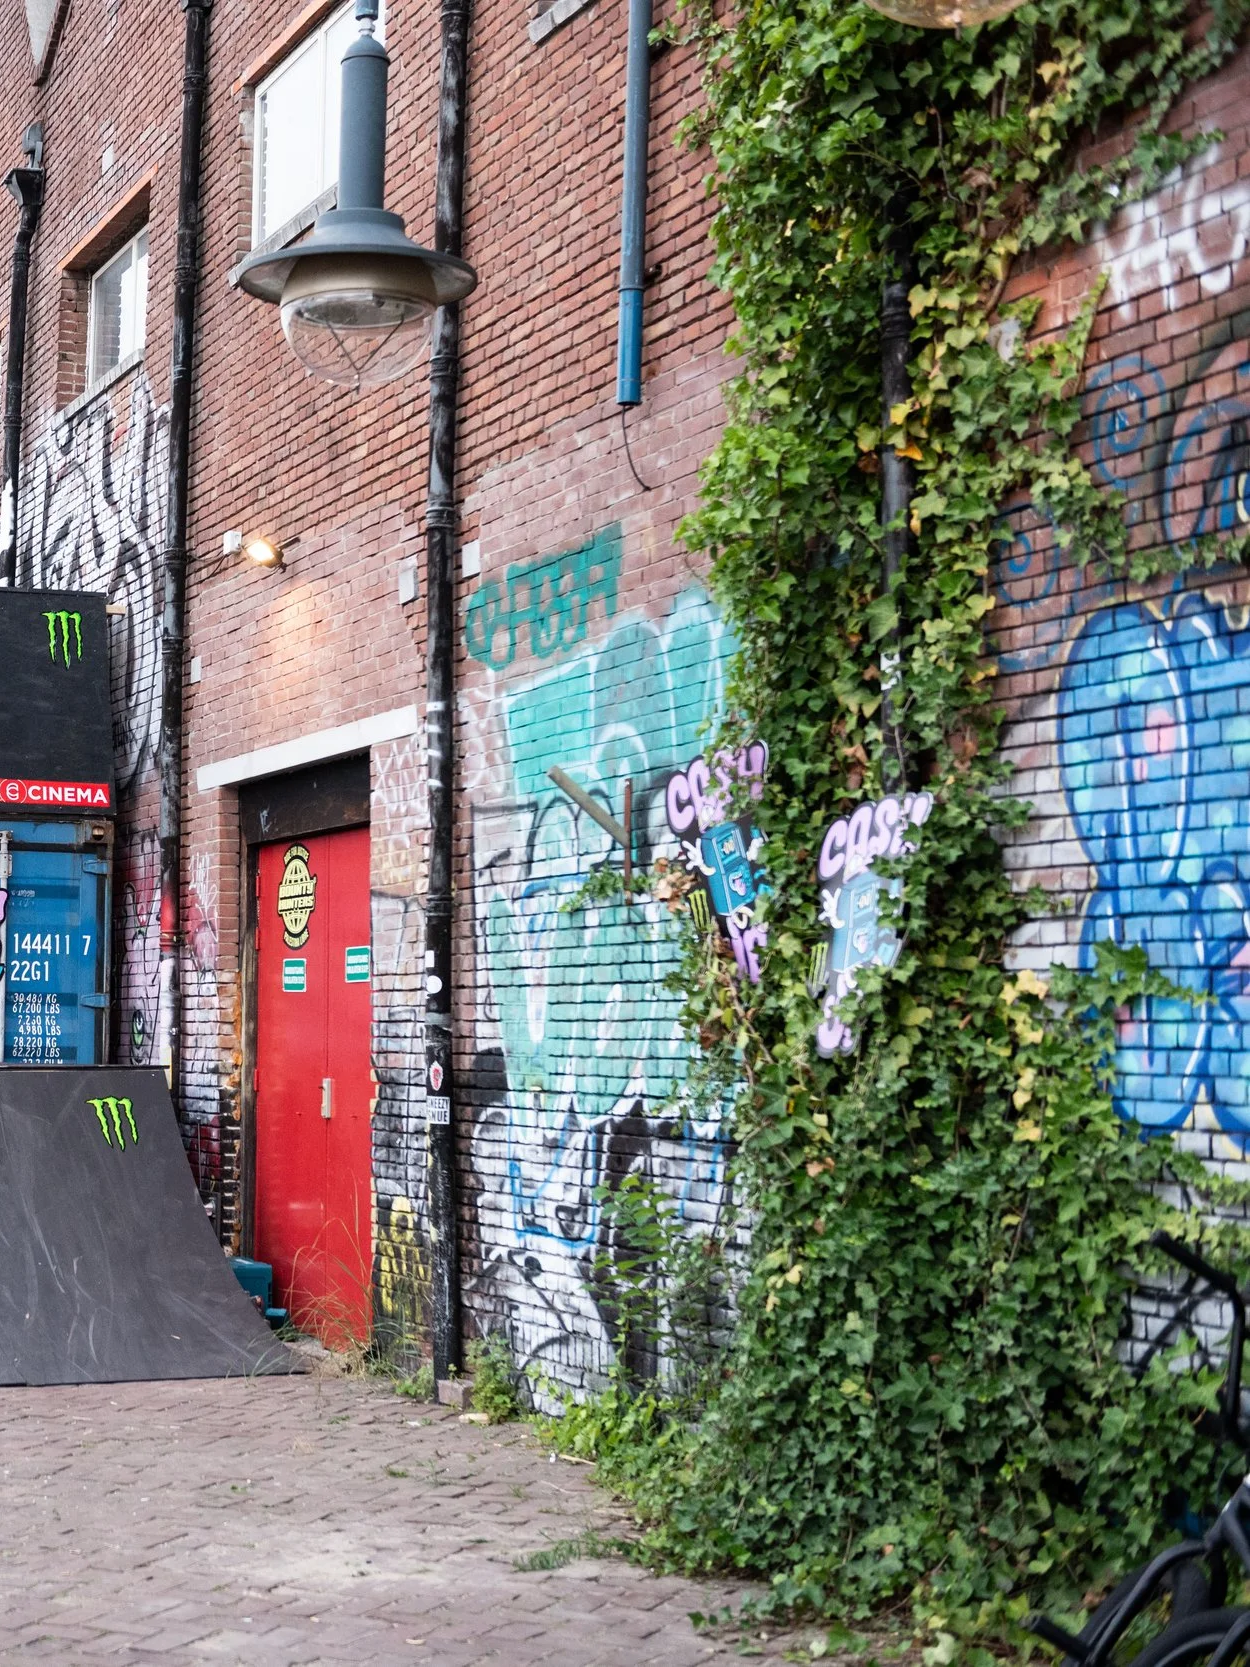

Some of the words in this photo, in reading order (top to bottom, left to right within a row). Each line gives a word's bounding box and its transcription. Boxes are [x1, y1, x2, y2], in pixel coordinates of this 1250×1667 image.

[27, 785, 108, 804] CINEMA
[13, 933, 70, 955] 144411
[82, 935, 91, 956] 7
[11, 960, 49, 981] 22G1
[13, 992, 43, 1003] 30.480
[45, 993, 57, 1004] KG
[12, 1003, 42, 1013] 67.200
[44, 1003, 60, 1014] LBS
[45, 1015, 56, 1025] KG
[18, 1025, 43, 1035] 4.980
[45, 1025, 61, 1036] LBS
[45, 1037, 57, 1048] KG
[44, 1047, 60, 1058] LBS
